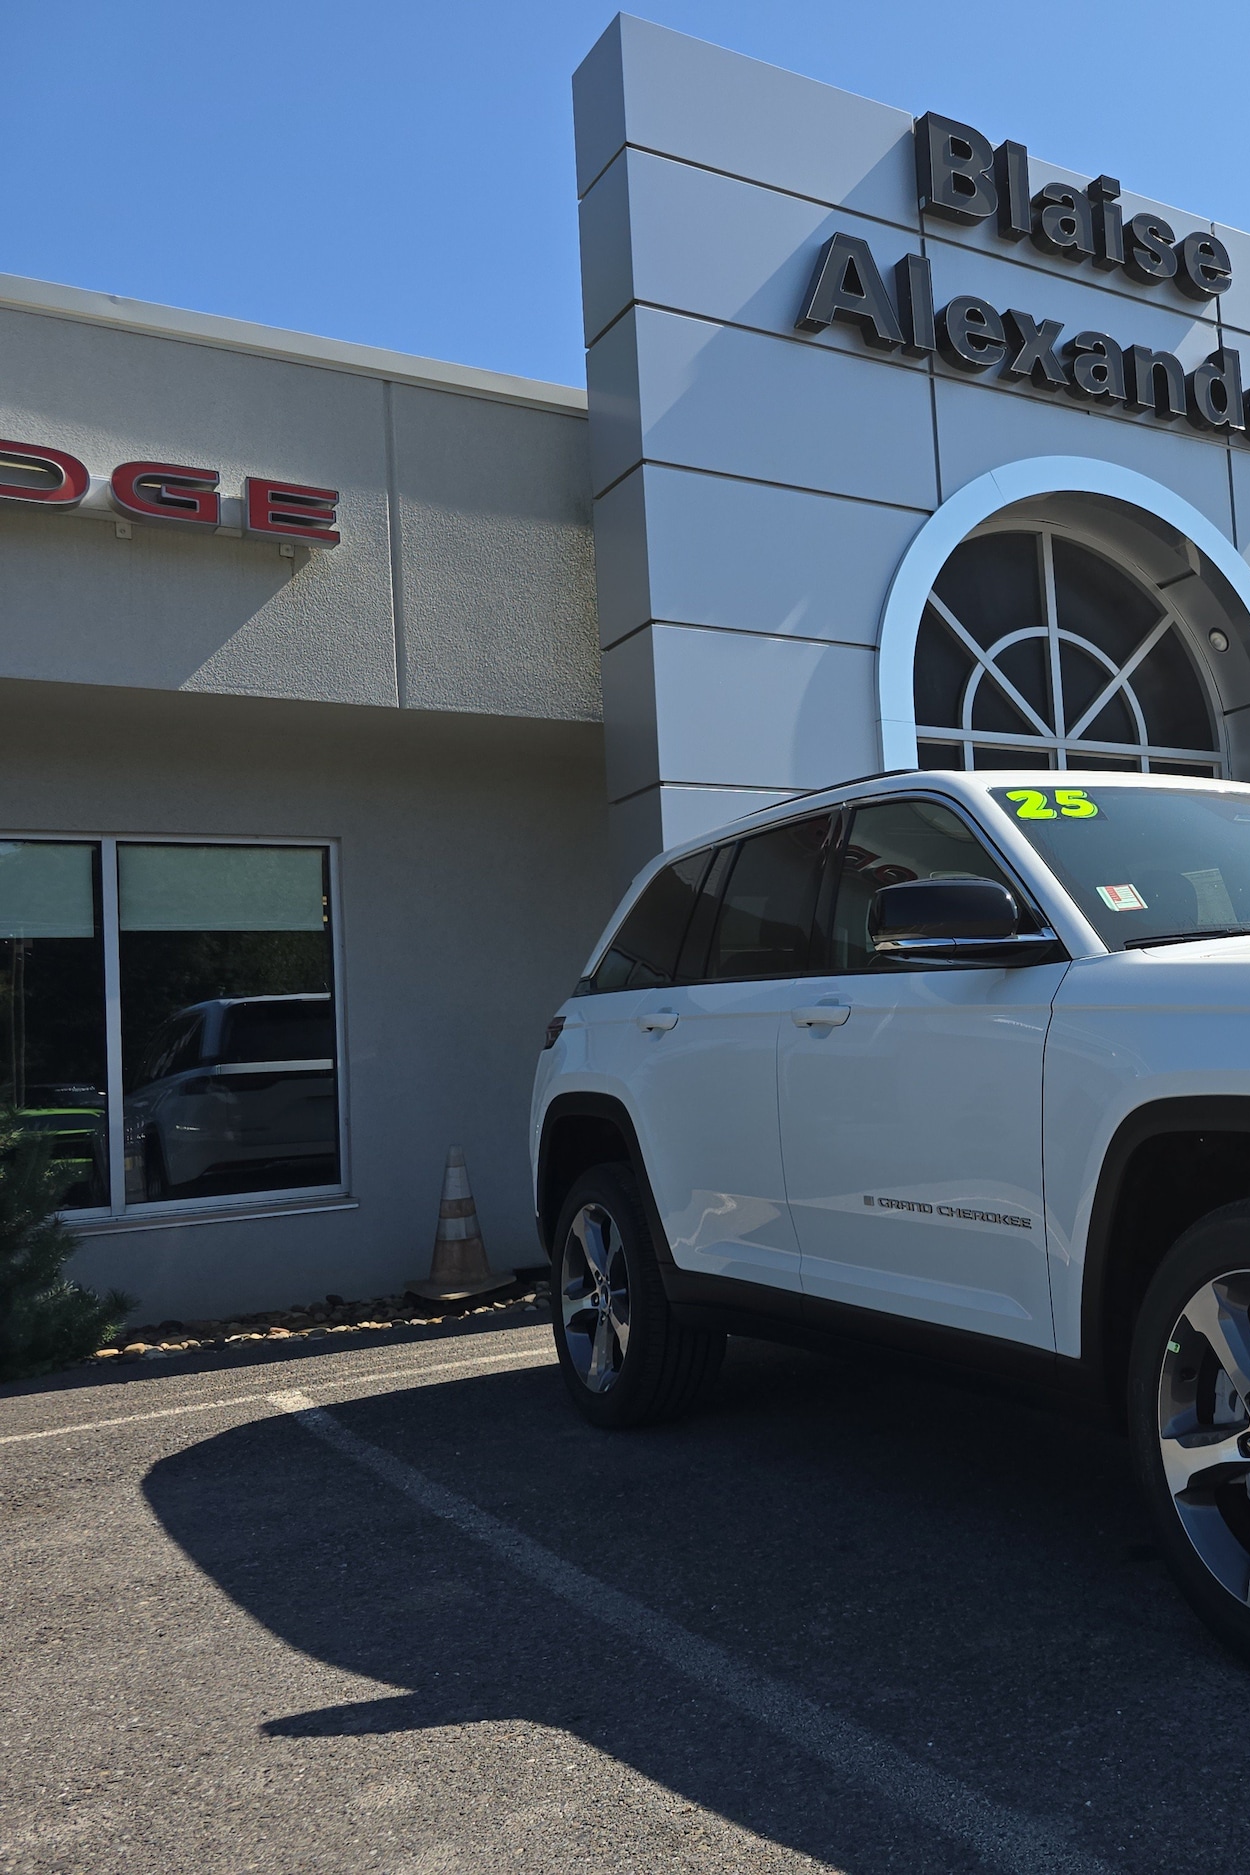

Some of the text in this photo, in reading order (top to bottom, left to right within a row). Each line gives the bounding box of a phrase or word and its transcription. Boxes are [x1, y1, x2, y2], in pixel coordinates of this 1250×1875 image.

[915, 111, 1232, 300] Blaise
[1005, 789, 1099, 820] 25
[877, 1197, 1032, 1230] GRAND CHEROKEE
